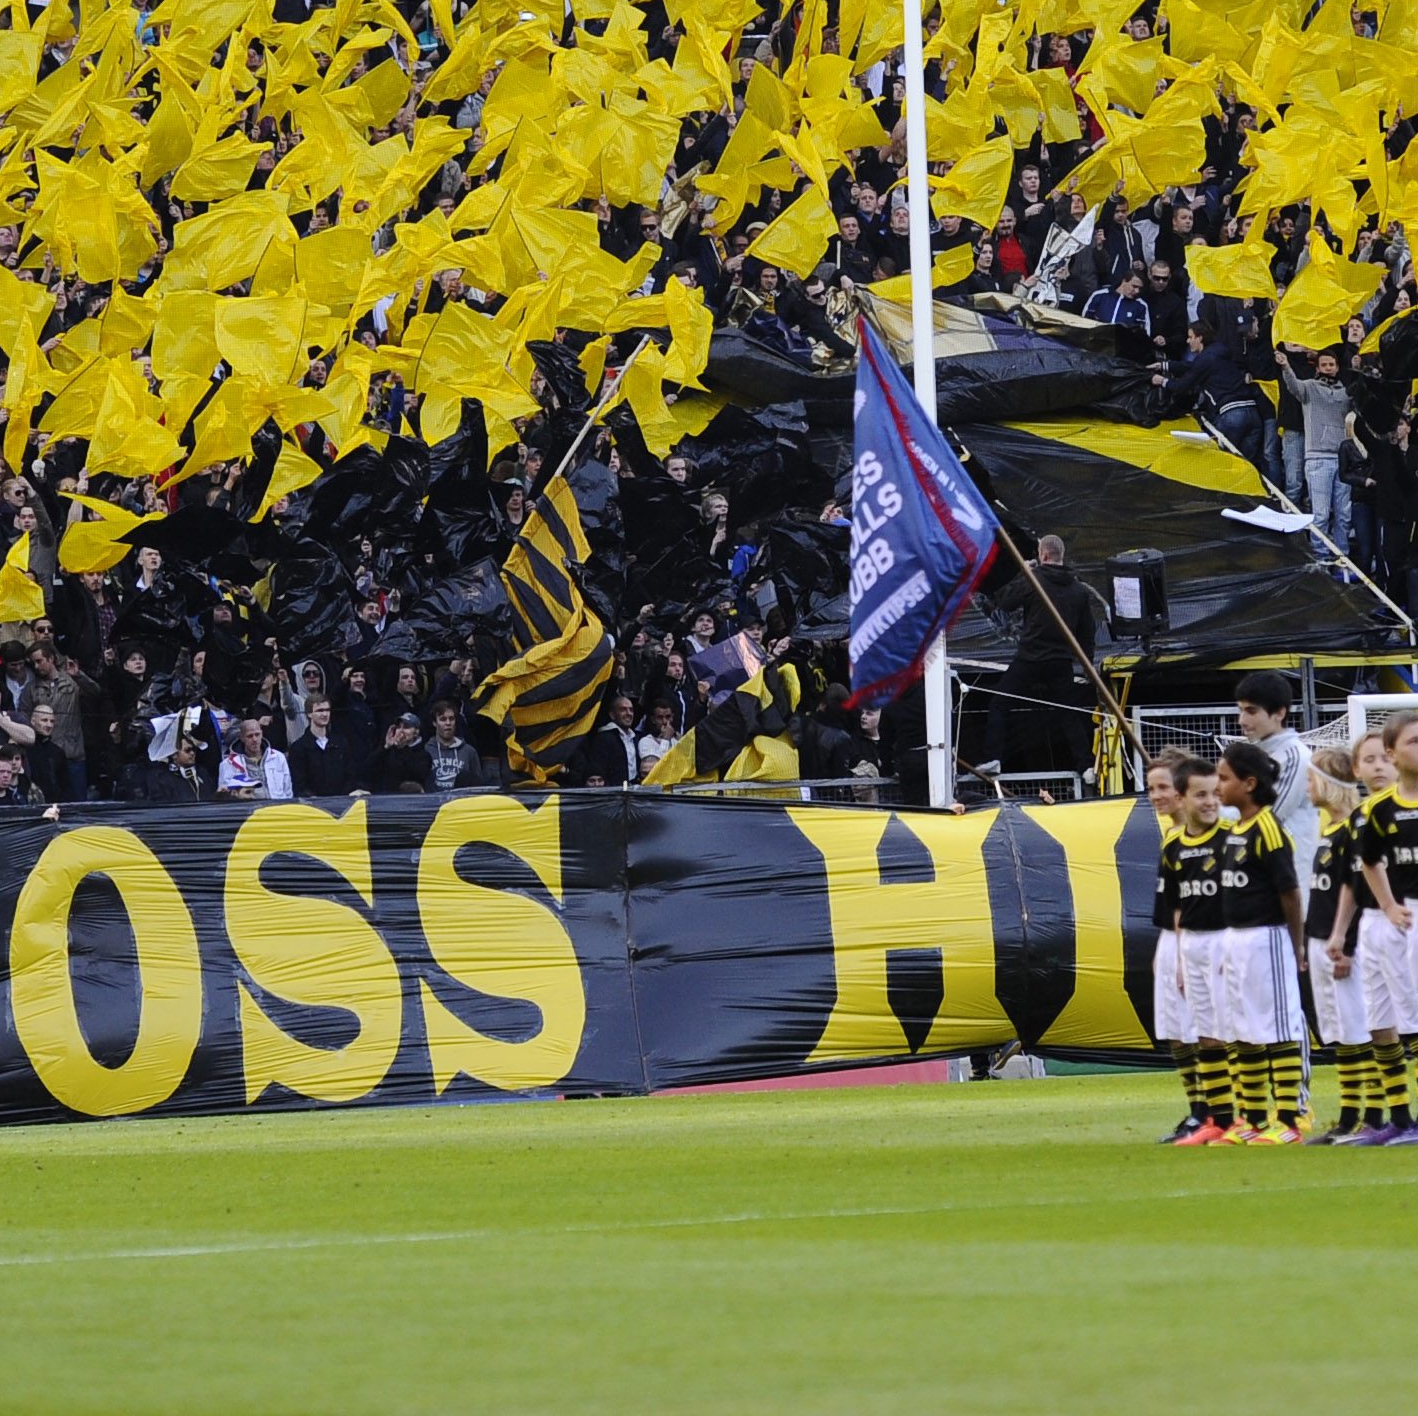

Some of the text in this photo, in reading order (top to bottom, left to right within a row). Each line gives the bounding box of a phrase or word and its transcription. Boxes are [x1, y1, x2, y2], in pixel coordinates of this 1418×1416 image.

[851, 449, 884, 504] ES
[849, 537, 895, 618] UBB
[848, 577, 932, 666] STRYKTIPSET
[9, 792, 587, 1118] OSS
[784, 798, 1159, 1062] HI
